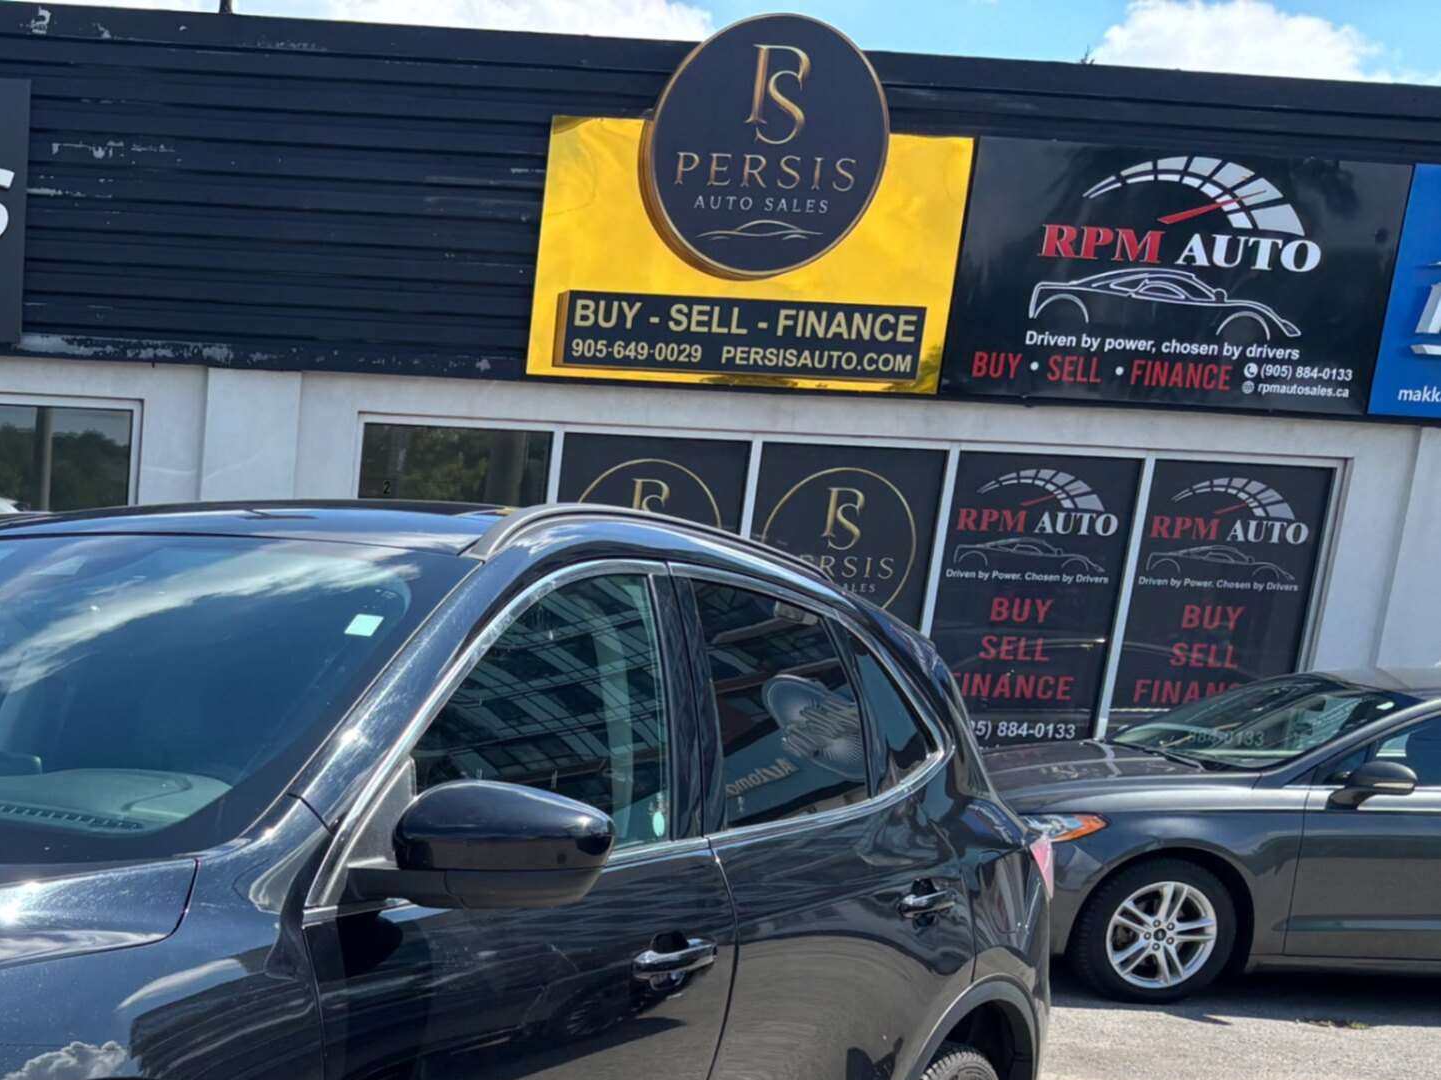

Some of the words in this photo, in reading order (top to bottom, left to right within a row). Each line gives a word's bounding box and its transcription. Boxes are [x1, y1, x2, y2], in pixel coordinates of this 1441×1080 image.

[674, 151, 858, 192] PERSIS
[693, 194, 754, 212] AUTO
[763, 197, 830, 215] SALES
[1037, 222, 1167, 264] RPM
[1174, 232, 1322, 273] AUTO
[573, 299, 643, 330] BUY
[668, 304, 748, 336] SELL
[776, 308, 918, 343] FINANCE
[571, 338, 703, 363] 905-649-0029
[720, 345, 913, 373] PERSISAUTO.COM
[1025, 329, 1076, 347] Driven
[1080, 333, 1100, 351] by
[1104, 337, 1157, 355] power,
[1161, 339, 1218, 356] chosen
[1222, 342, 1243, 360] by
[1246, 343, 1300, 360] drivers
[971, 350, 1023, 379] BUY
[1046, 354, 1102, 384] SELL
[1129, 358, 1233, 391] FINANCE
[1260, 362, 1292, 380] (905)
[1295, 364, 1354, 382] 884-0133
[1257, 381, 1351, 399] rpmautosales.ca
[1397, 384, 1441, 403] makk
[955, 507, 1028, 534] RPM
[1033, 512, 1119, 537] AUTO
[1149, 515, 1223, 541] RPM
[1226, 520, 1309, 545] AUTO
[945, 568, 976, 579] Driven
[978, 570, 990, 582] by
[1024, 571, 1061, 582] Chosen
[1062, 573, 1074, 584] by
[1076, 574, 1109, 584] Drivers
[1138, 576, 1168, 586] Driven
[1170, 578, 1182, 588] by
[1216, 579, 1251, 589] Chosen
[1253, 581, 1264, 592] by
[1266, 582, 1299, 592] Drivers
[989, 597, 1054, 624] BUY
[1181, 603, 1245, 631] BUY
[978, 635, 1050, 662] SELL
[1169, 642, 1240, 670] SELL
[997, 721, 1076, 739] 884-0133
